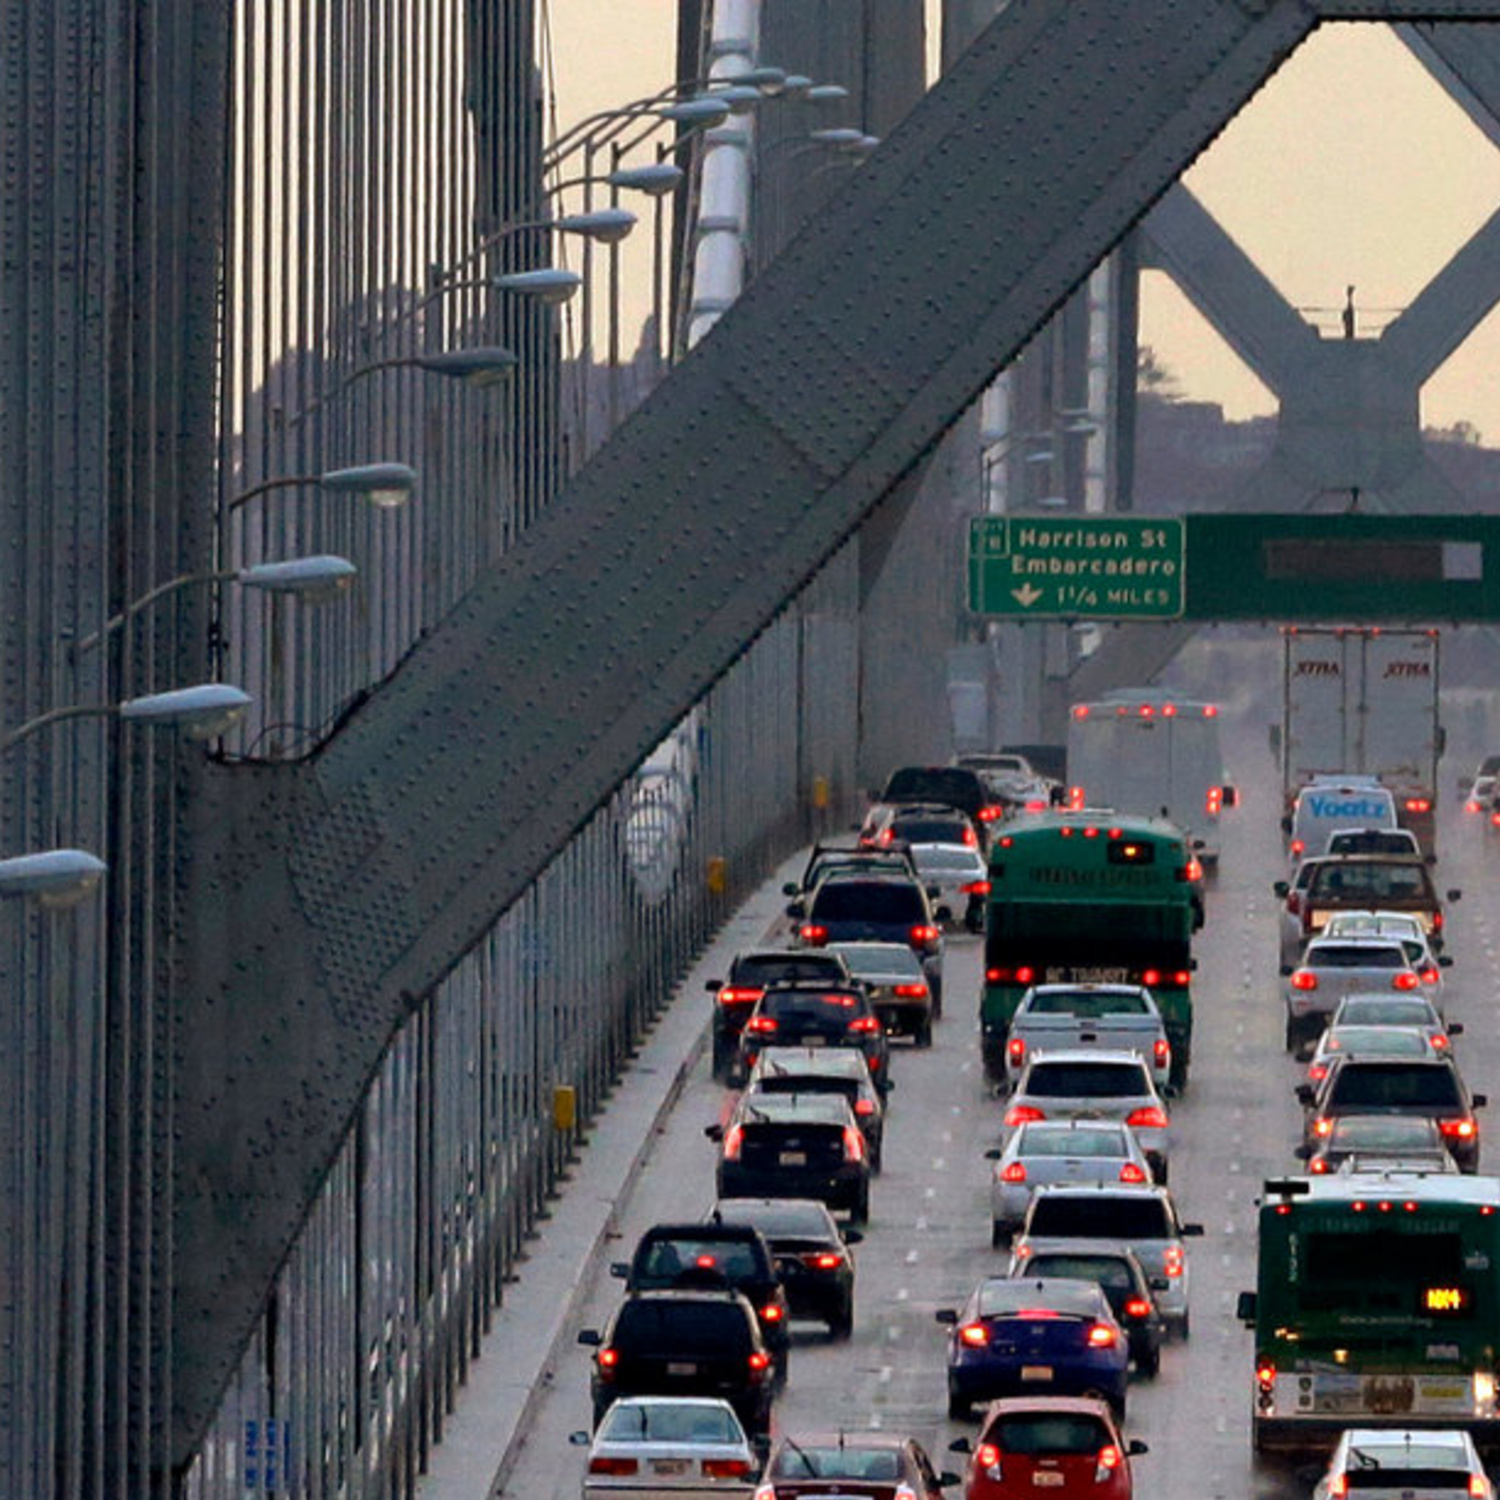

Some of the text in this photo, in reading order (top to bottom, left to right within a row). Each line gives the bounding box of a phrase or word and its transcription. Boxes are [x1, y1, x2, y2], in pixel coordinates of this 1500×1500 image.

[1019, 528, 1167, 548] Harrison St
[1011, 554, 1176, 575] Embarcadero
